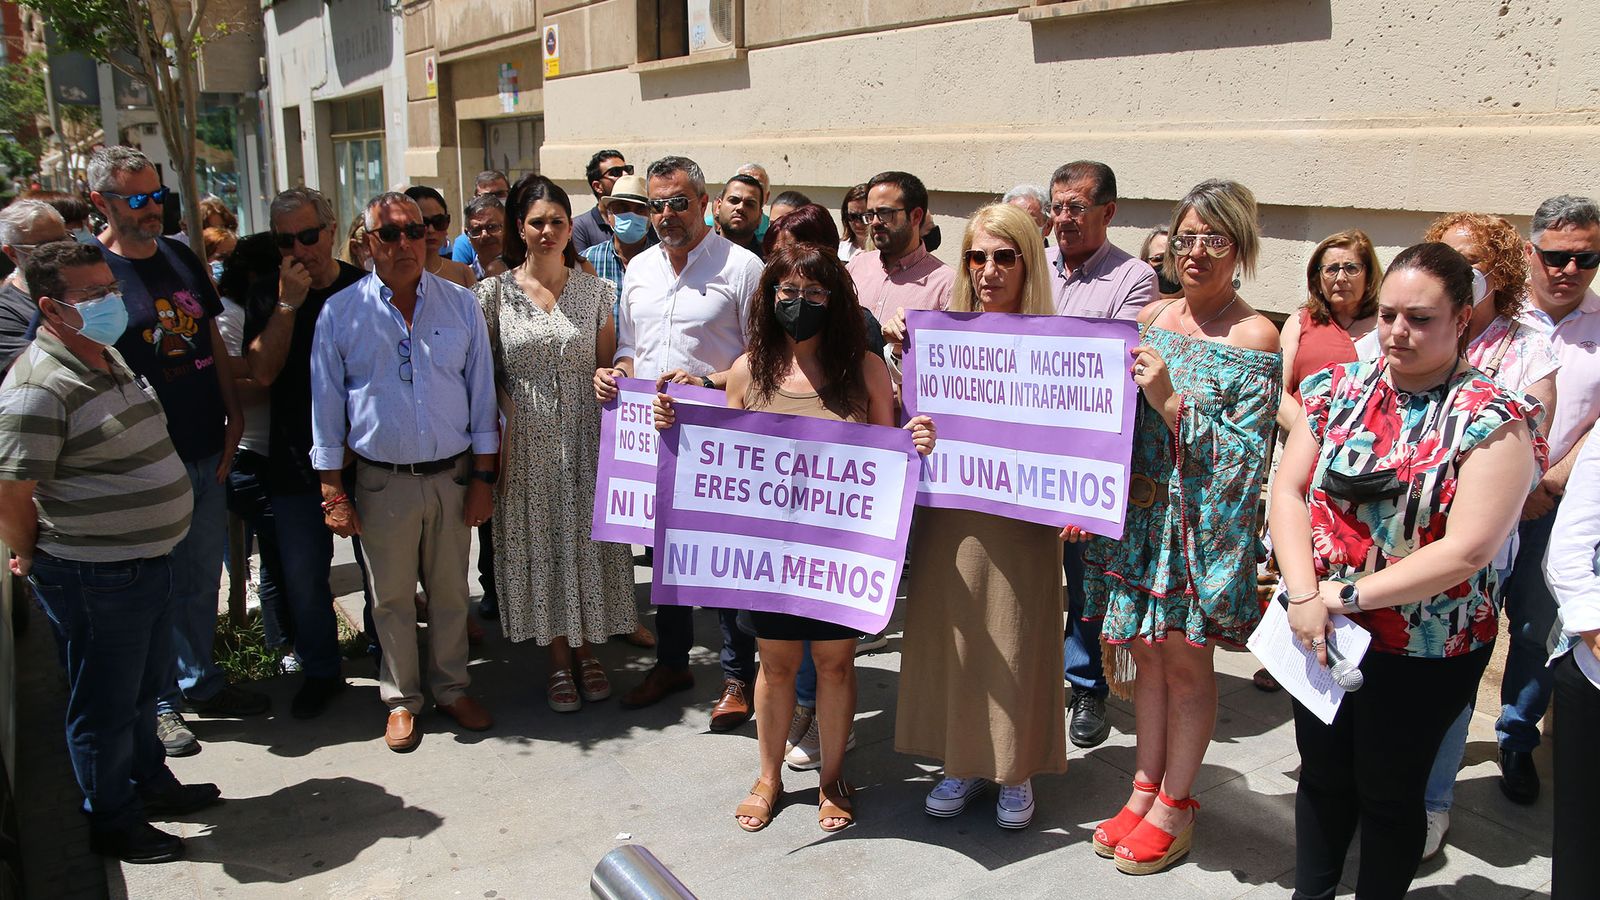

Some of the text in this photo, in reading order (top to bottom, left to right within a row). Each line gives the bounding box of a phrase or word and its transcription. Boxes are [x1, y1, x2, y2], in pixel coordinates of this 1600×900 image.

[929, 343, 1104, 379] ES VIOLENCIA MACHISTA
[620, 401, 651, 426] ESTE
[920, 373, 1113, 414] NO VIOLENCIA INTRAFAMILIAR
[619, 429, 635, 451] NO
[638, 432, 650, 453] SE
[699, 440, 876, 487] SI TE CALLAS
[919, 453, 1116, 511] NI UNA MENOS
[610, 489, 635, 517] NI
[694, 473, 874, 521] ERES CÓMPLICE
[667, 543, 886, 603] NI UNA MENOS
